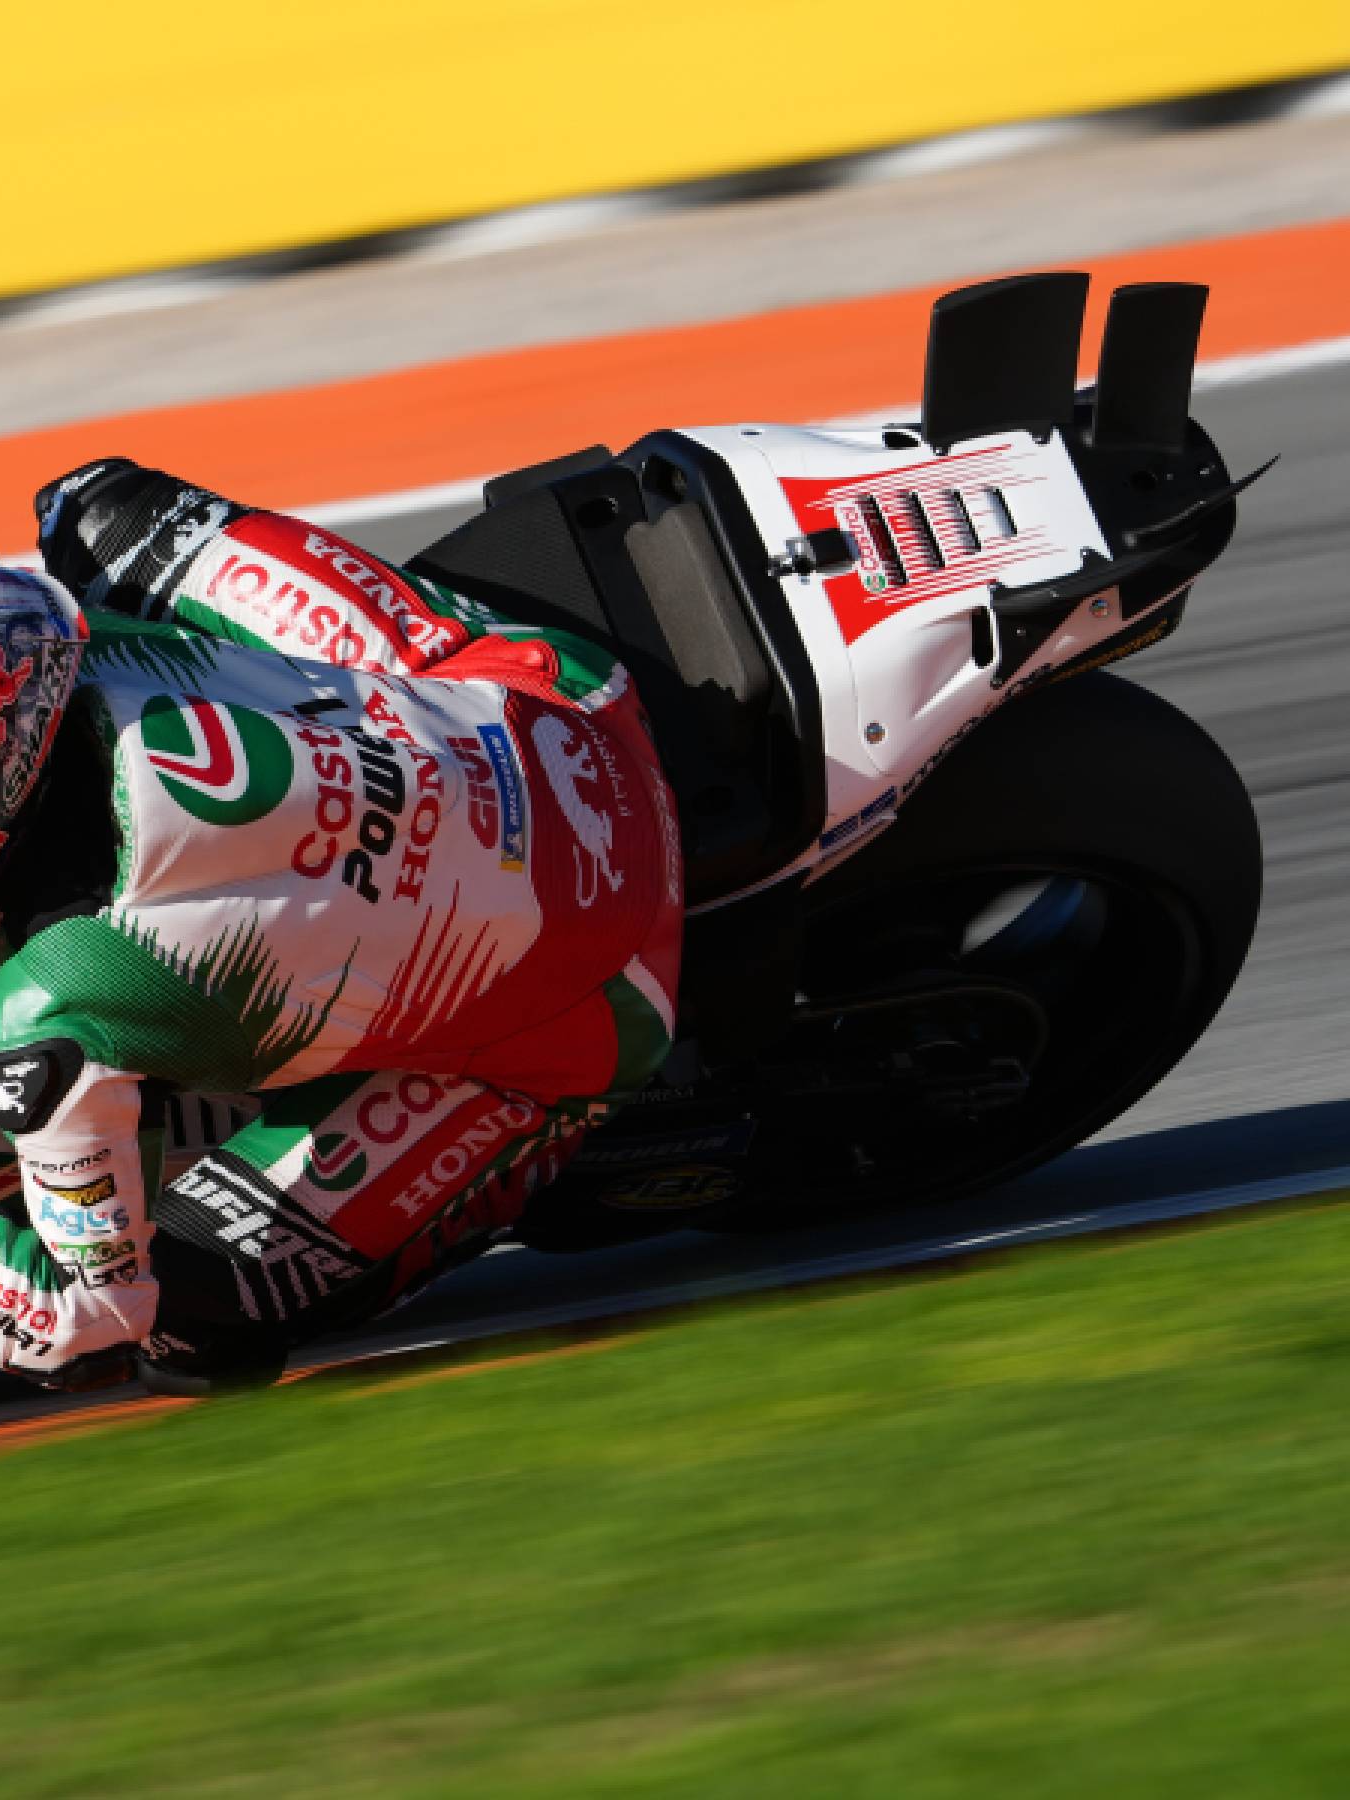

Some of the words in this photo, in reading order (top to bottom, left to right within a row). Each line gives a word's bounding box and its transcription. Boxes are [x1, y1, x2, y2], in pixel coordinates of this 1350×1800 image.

[207, 554, 387, 672] astrol
[304, 531, 454, 662] HONDA
[447, 737, 500, 849] GIVI
